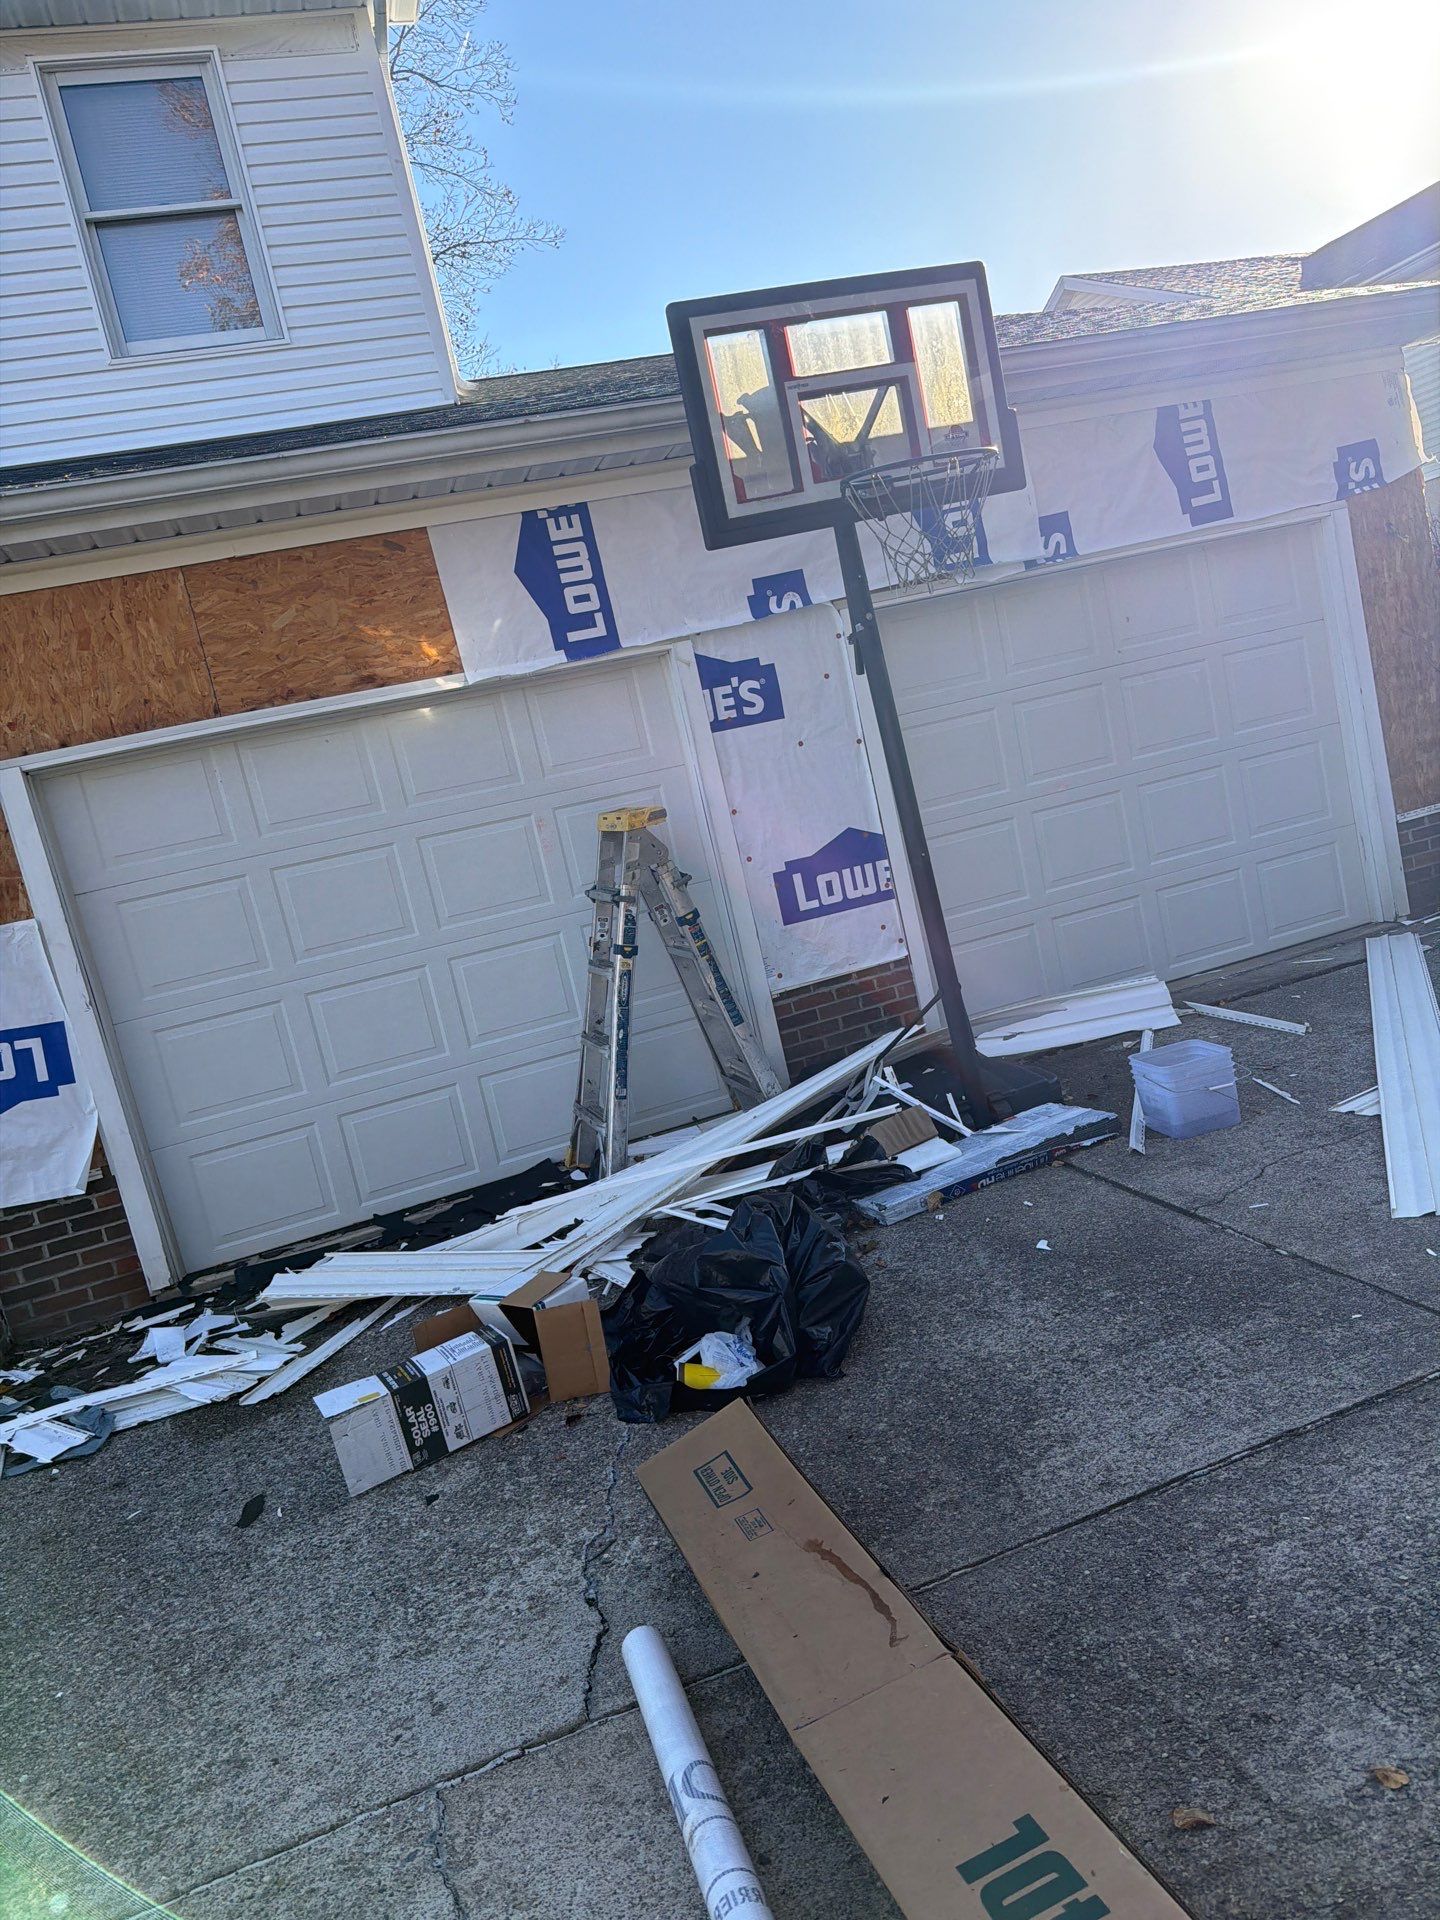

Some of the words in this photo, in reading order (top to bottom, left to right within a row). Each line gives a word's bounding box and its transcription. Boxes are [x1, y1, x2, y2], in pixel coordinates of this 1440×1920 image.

[404, 1405, 424, 1447] SOLAR
[416, 1406, 431, 1438] SEAL
[424, 1403, 440, 1432] #900
[720, 1466, 739, 1485] SIDE
